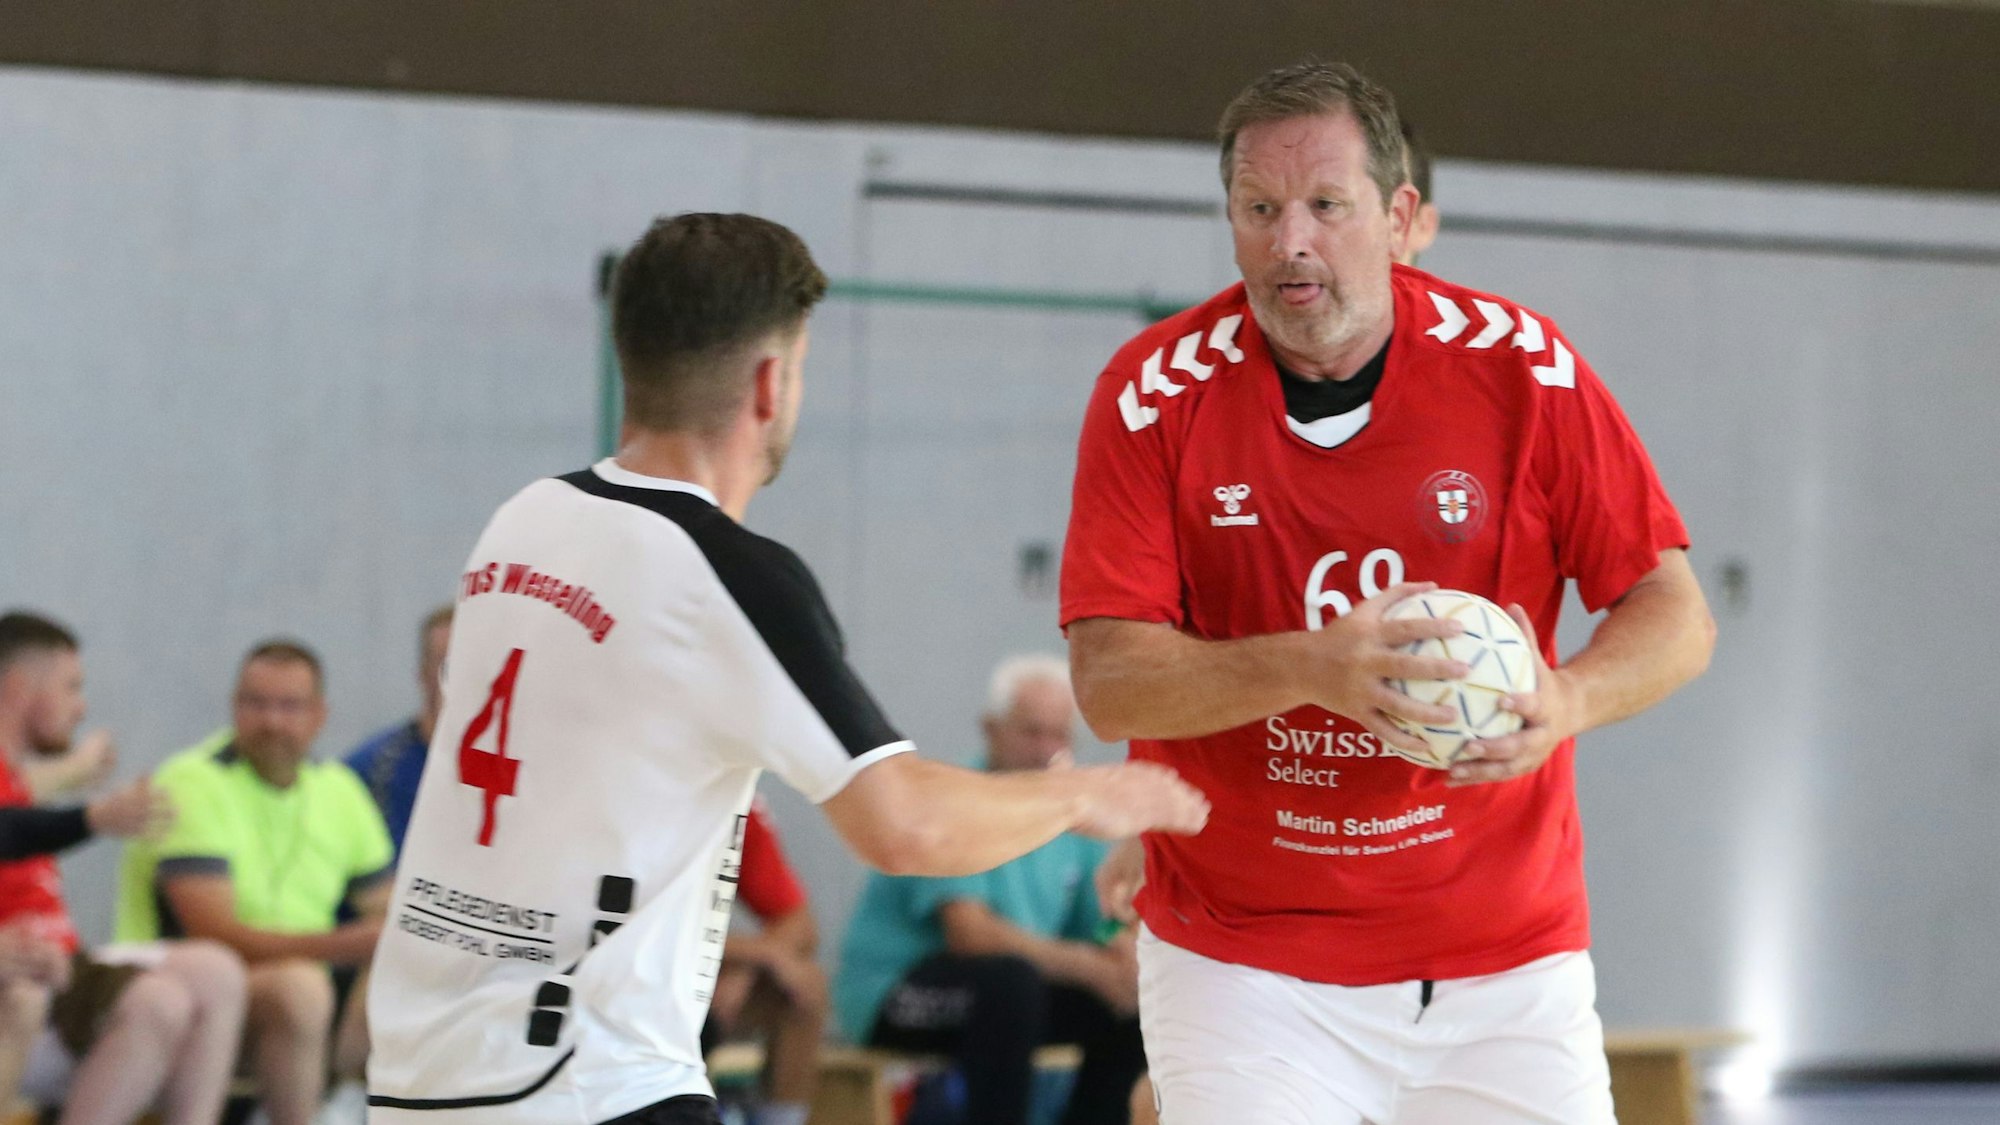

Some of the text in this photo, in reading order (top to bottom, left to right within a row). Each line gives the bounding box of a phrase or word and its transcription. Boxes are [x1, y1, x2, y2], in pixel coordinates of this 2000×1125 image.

[1210, 513, 1259, 527] hummel
[501, 563, 616, 644] Wesseling
[459, 648, 526, 847] 4
[1266, 716, 1399, 758] Swiss
[1267, 757, 1340, 788] Select
[1276, 805, 1446, 836] Martin Schneider
[406, 877, 557, 932] PFLEGEDIENST
